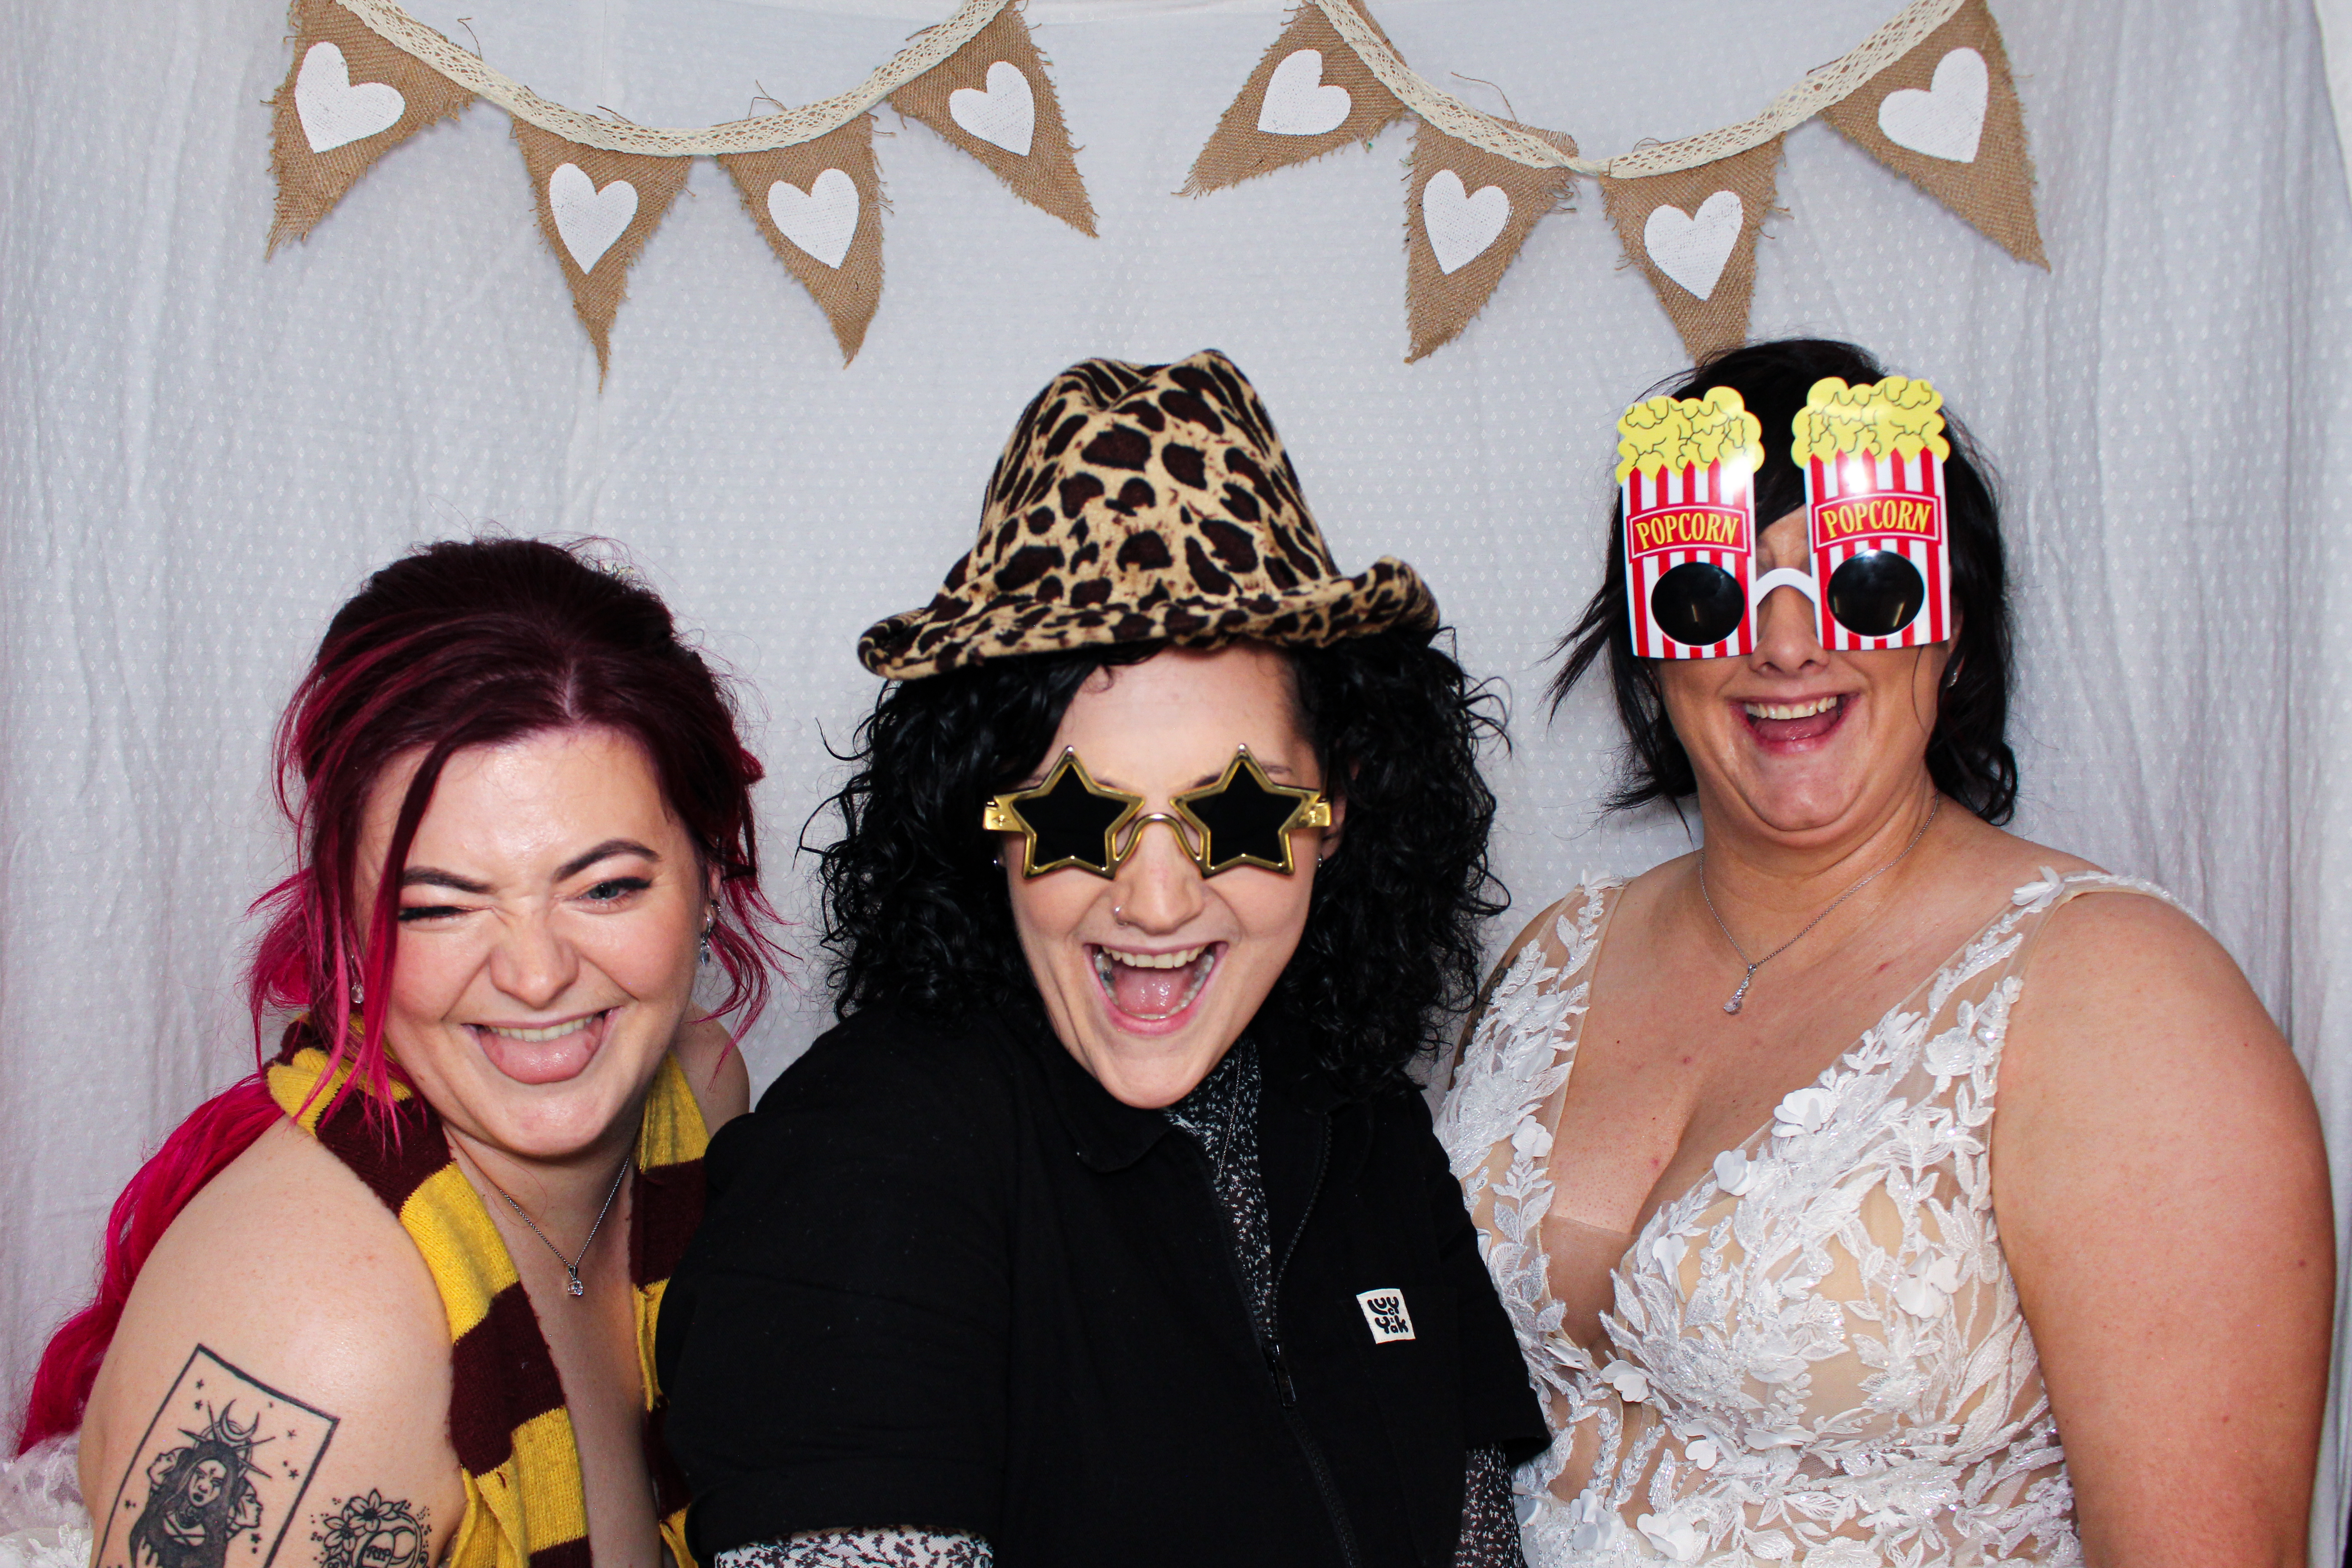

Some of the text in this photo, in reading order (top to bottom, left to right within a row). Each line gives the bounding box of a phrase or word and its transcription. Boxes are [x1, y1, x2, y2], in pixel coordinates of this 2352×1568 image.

[1636, 513, 1739, 549] POPCORN
[1822, 500, 1932, 539] POPCORN
[1375, 1315, 1408, 1334] Yak
[365, 1545, 392, 1561] RIP
